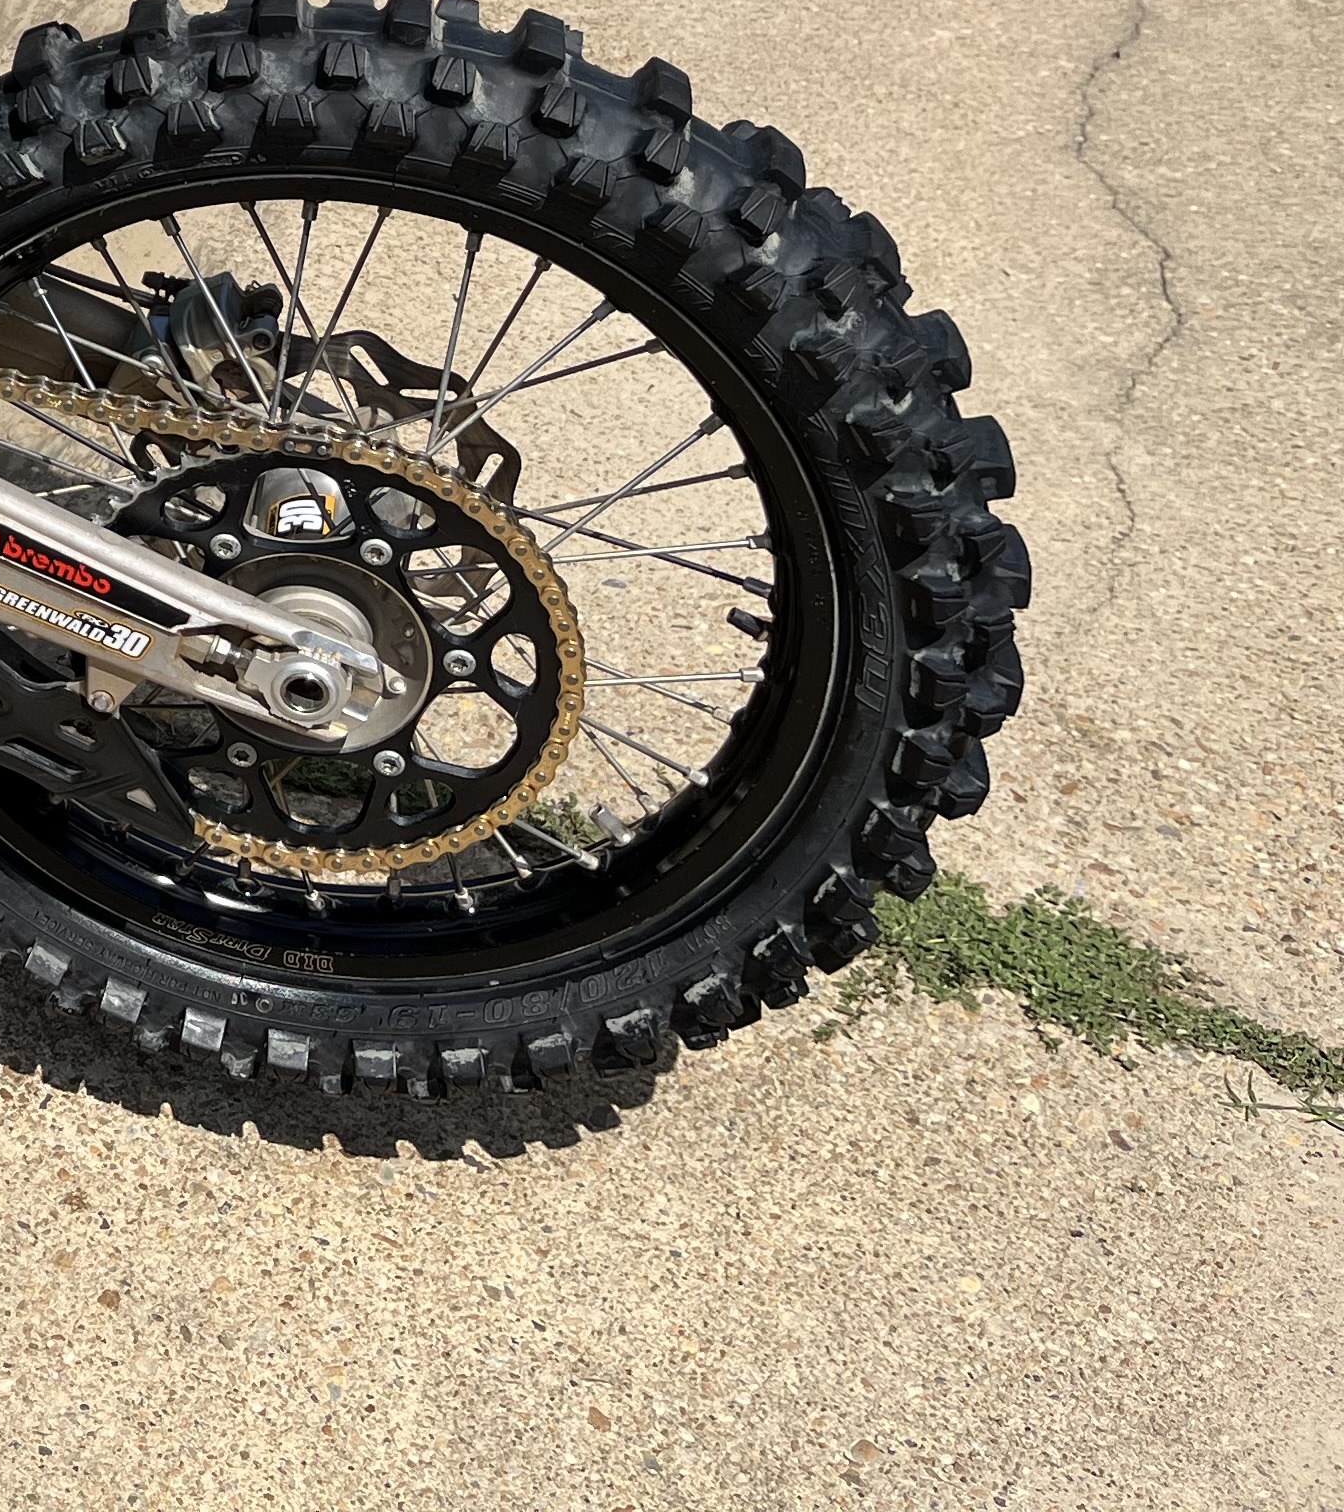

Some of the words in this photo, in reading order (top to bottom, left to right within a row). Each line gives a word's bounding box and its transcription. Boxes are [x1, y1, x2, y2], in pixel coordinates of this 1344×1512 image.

[4, 535, 110, 594] brembo
[105, 625, 152, 660] 30
[283, 948, 336, 974] D.I.D
